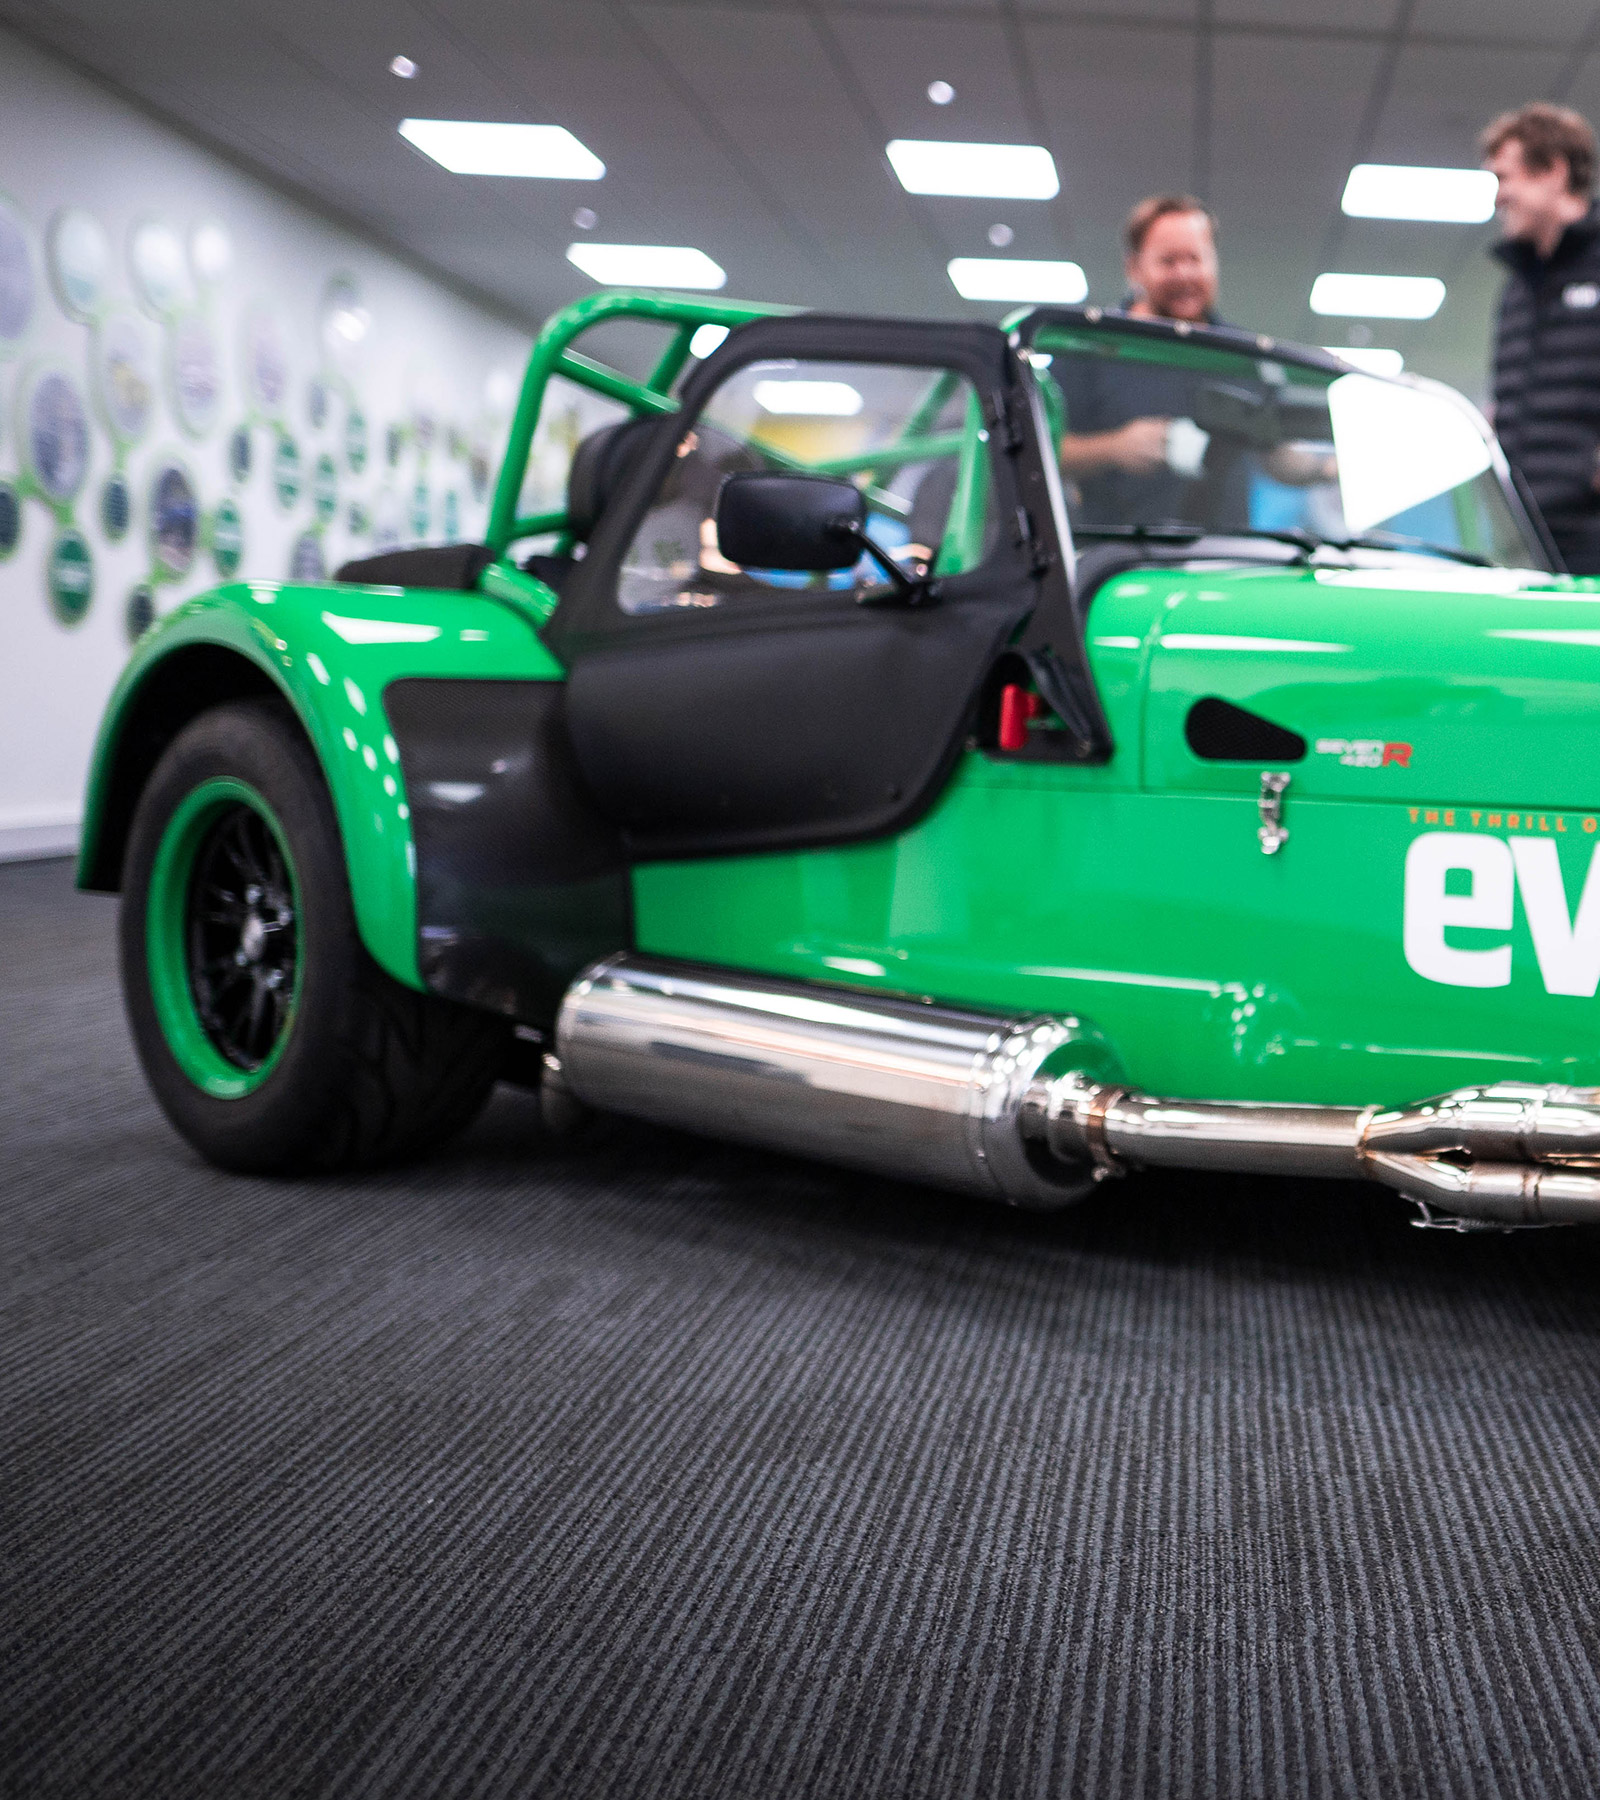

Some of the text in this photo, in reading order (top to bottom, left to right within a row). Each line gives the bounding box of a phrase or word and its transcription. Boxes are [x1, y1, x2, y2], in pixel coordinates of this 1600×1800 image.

[1382, 742, 1413, 768] R
[1408, 807, 1455, 826] THE
[1470, 811, 1567, 832] THRILL
